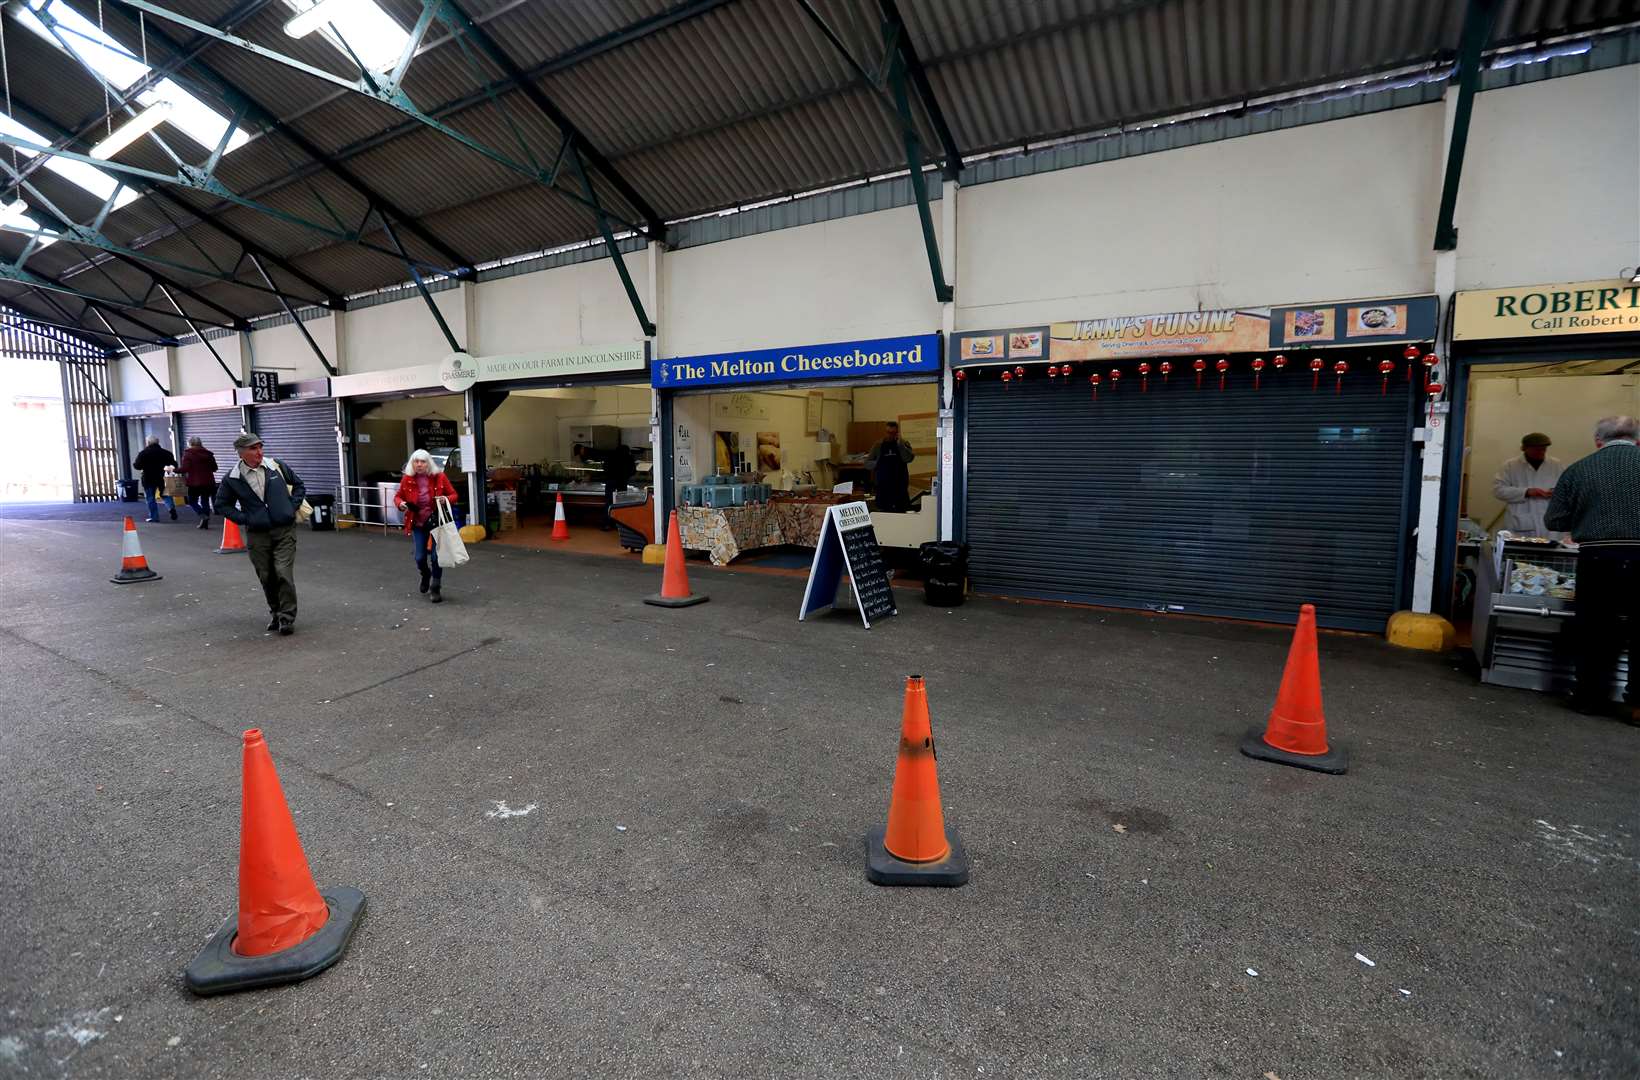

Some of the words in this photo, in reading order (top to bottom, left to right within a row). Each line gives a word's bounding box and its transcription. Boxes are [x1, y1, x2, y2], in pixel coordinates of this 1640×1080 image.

[1495, 286, 1640, 317] ROBERT
[1071, 316, 1147, 341] JENNY'S
[1150, 311, 1237, 336] CUISINE
[1531, 317, 1563, 330] Call
[1569, 314, 1623, 328] Robert
[486, 363, 508, 373] MADE
[509, 361, 520, 371] ON
[522, 359, 538, 370] OUR
[541, 357, 564, 368] FARM
[566, 356, 575, 366] IN
[576, 350, 642, 365] LINCOLNSHIRE
[672, 364, 705, 380] The
[710, 359, 775, 377] Melton
[781, 345, 922, 373] Cheeseboard
[254, 373, 268, 387] 13
[442, 369, 476, 381] GRASMERE
[255, 387, 270, 401] 24
[839, 505, 864, 517] MELTON
